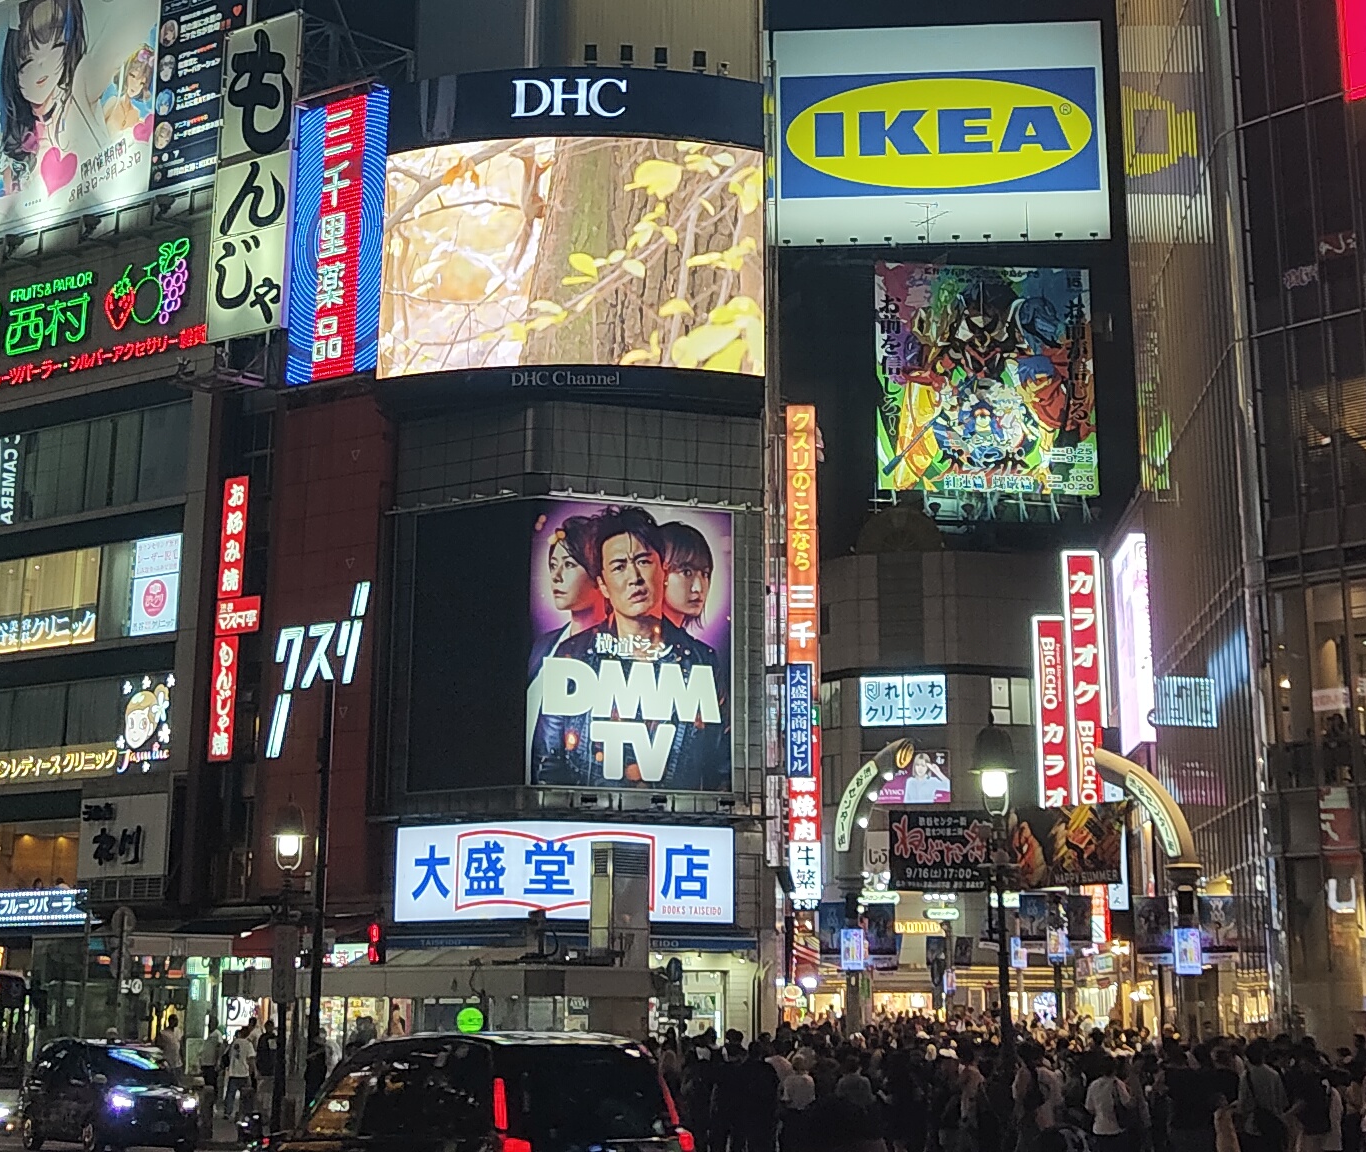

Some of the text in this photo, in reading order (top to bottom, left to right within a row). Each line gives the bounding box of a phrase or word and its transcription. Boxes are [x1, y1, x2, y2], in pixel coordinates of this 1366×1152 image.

[511, 78, 628, 119] DHC
[814, 105, 1072, 158] IKEA
[214, 28, 292, 325] もんじゃ
[312, 107, 355, 361] 三千里薬品
[9, 270, 93, 303] FRUITS&PARLOR
[5, 292, 90, 357] 西村
[511, 371, 621, 387] DHC Channel
[791, 413, 814, 571] クスリのことなら
[1070, 475, 1095, 483] 10.6
[221, 483, 245, 592] お好み焼
[594, 632, 674, 662] 横道ドラゴン
[1039, 636, 1056, 666] BIG
[1068, 571, 1101, 706] カラオケ
[267, 581, 372, 760] クスリ
[541, 656, 722, 724] DMM
[884, 681, 945, 701] れいわ
[1043, 666, 1058, 710] ECHO
[211, 641, 235, 756] もんじゃ焼
[789, 669, 809, 773] 大盛堂商事ビル
[864, 703, 945, 723] クリニック
[588, 722, 676, 783] TV
[1078, 720, 1098, 805] BIG ECHO
[791, 795, 817, 841] 焼肉
[837, 765, 873, 849] 渋谷センター街
[412, 840, 712, 901] 大盛堂店
[796, 845, 816, 890] 牛繁
[1082, 868, 1120, 882] SUMMER
[661, 905, 722, 916] BOOKS TAISEIDO
[419, 938, 462, 947] TAISEIDO
